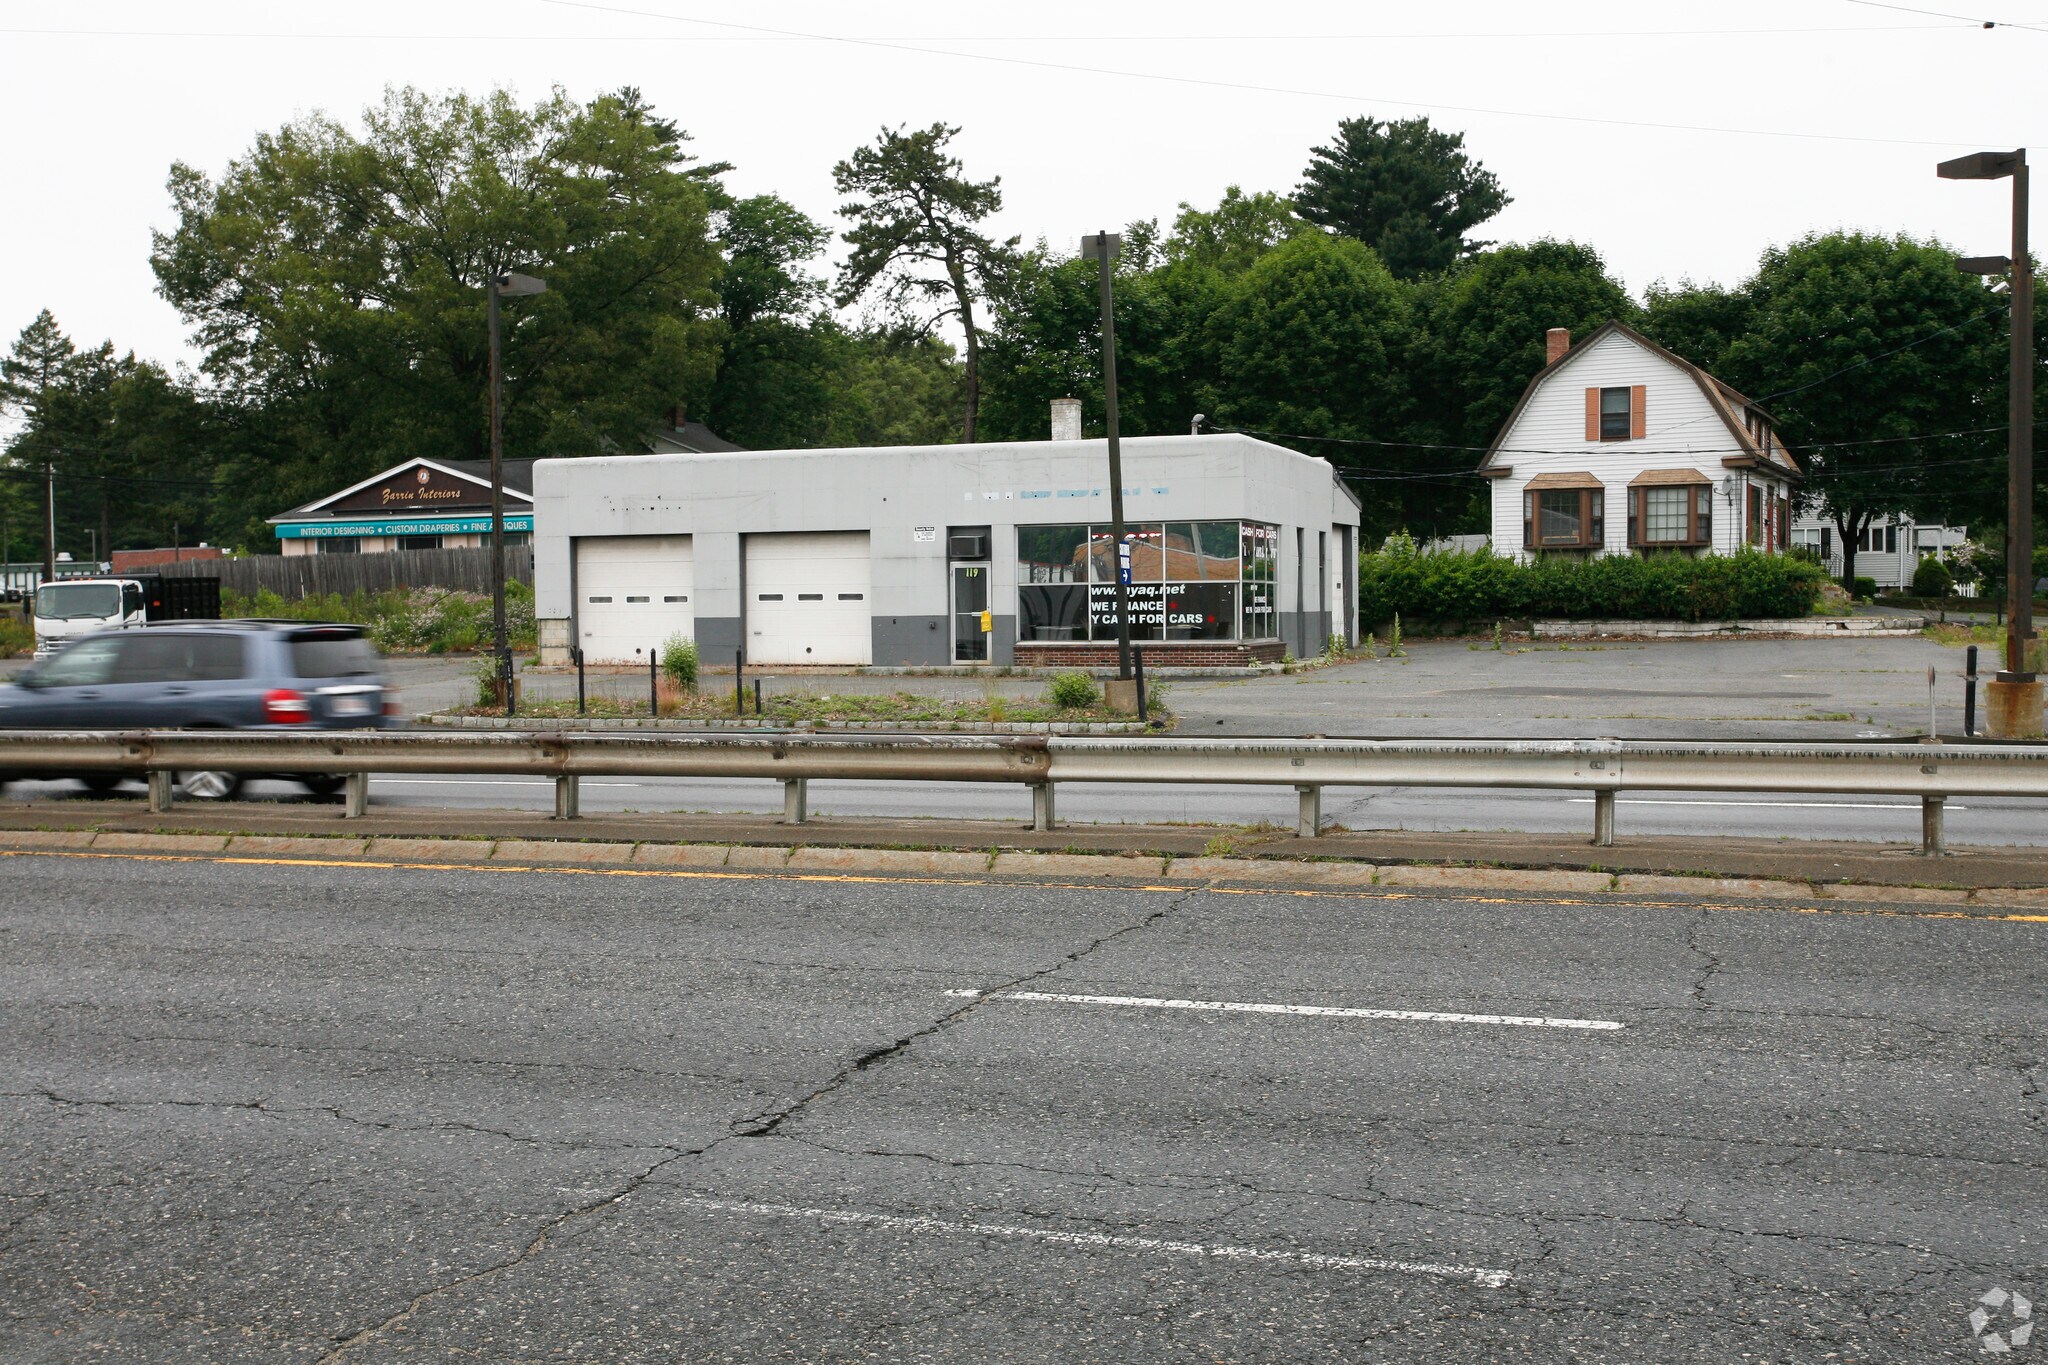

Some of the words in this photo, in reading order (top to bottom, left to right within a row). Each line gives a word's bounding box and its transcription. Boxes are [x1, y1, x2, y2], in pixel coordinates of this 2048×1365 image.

[382, 488, 414, 505] Zarrin
[418, 487, 461, 500] Interiors
[301, 527, 332, 536] INTERIOR
[334, 526, 375, 535] DESIGNING
[385, 525, 418, 534] CUSTOM
[420, 523, 460, 533] DRAPERIES
[471, 522, 487, 531] FINE
[489, 521, 528, 530] AIQUES
[1241, 526, 1254, 537] CASH
[1255, 528, 1265, 539] FOR
[1266, 530, 1277, 540] CARS
[966, 568, 979, 577] 119
[1091, 602, 1109, 612] WE
[1112, 601, 1164, 611] FNANCE
[1102, 614, 1136, 624] CAH
[1139, 614, 1164, 624] FOR
[1169, 614, 1203, 624] CARS
